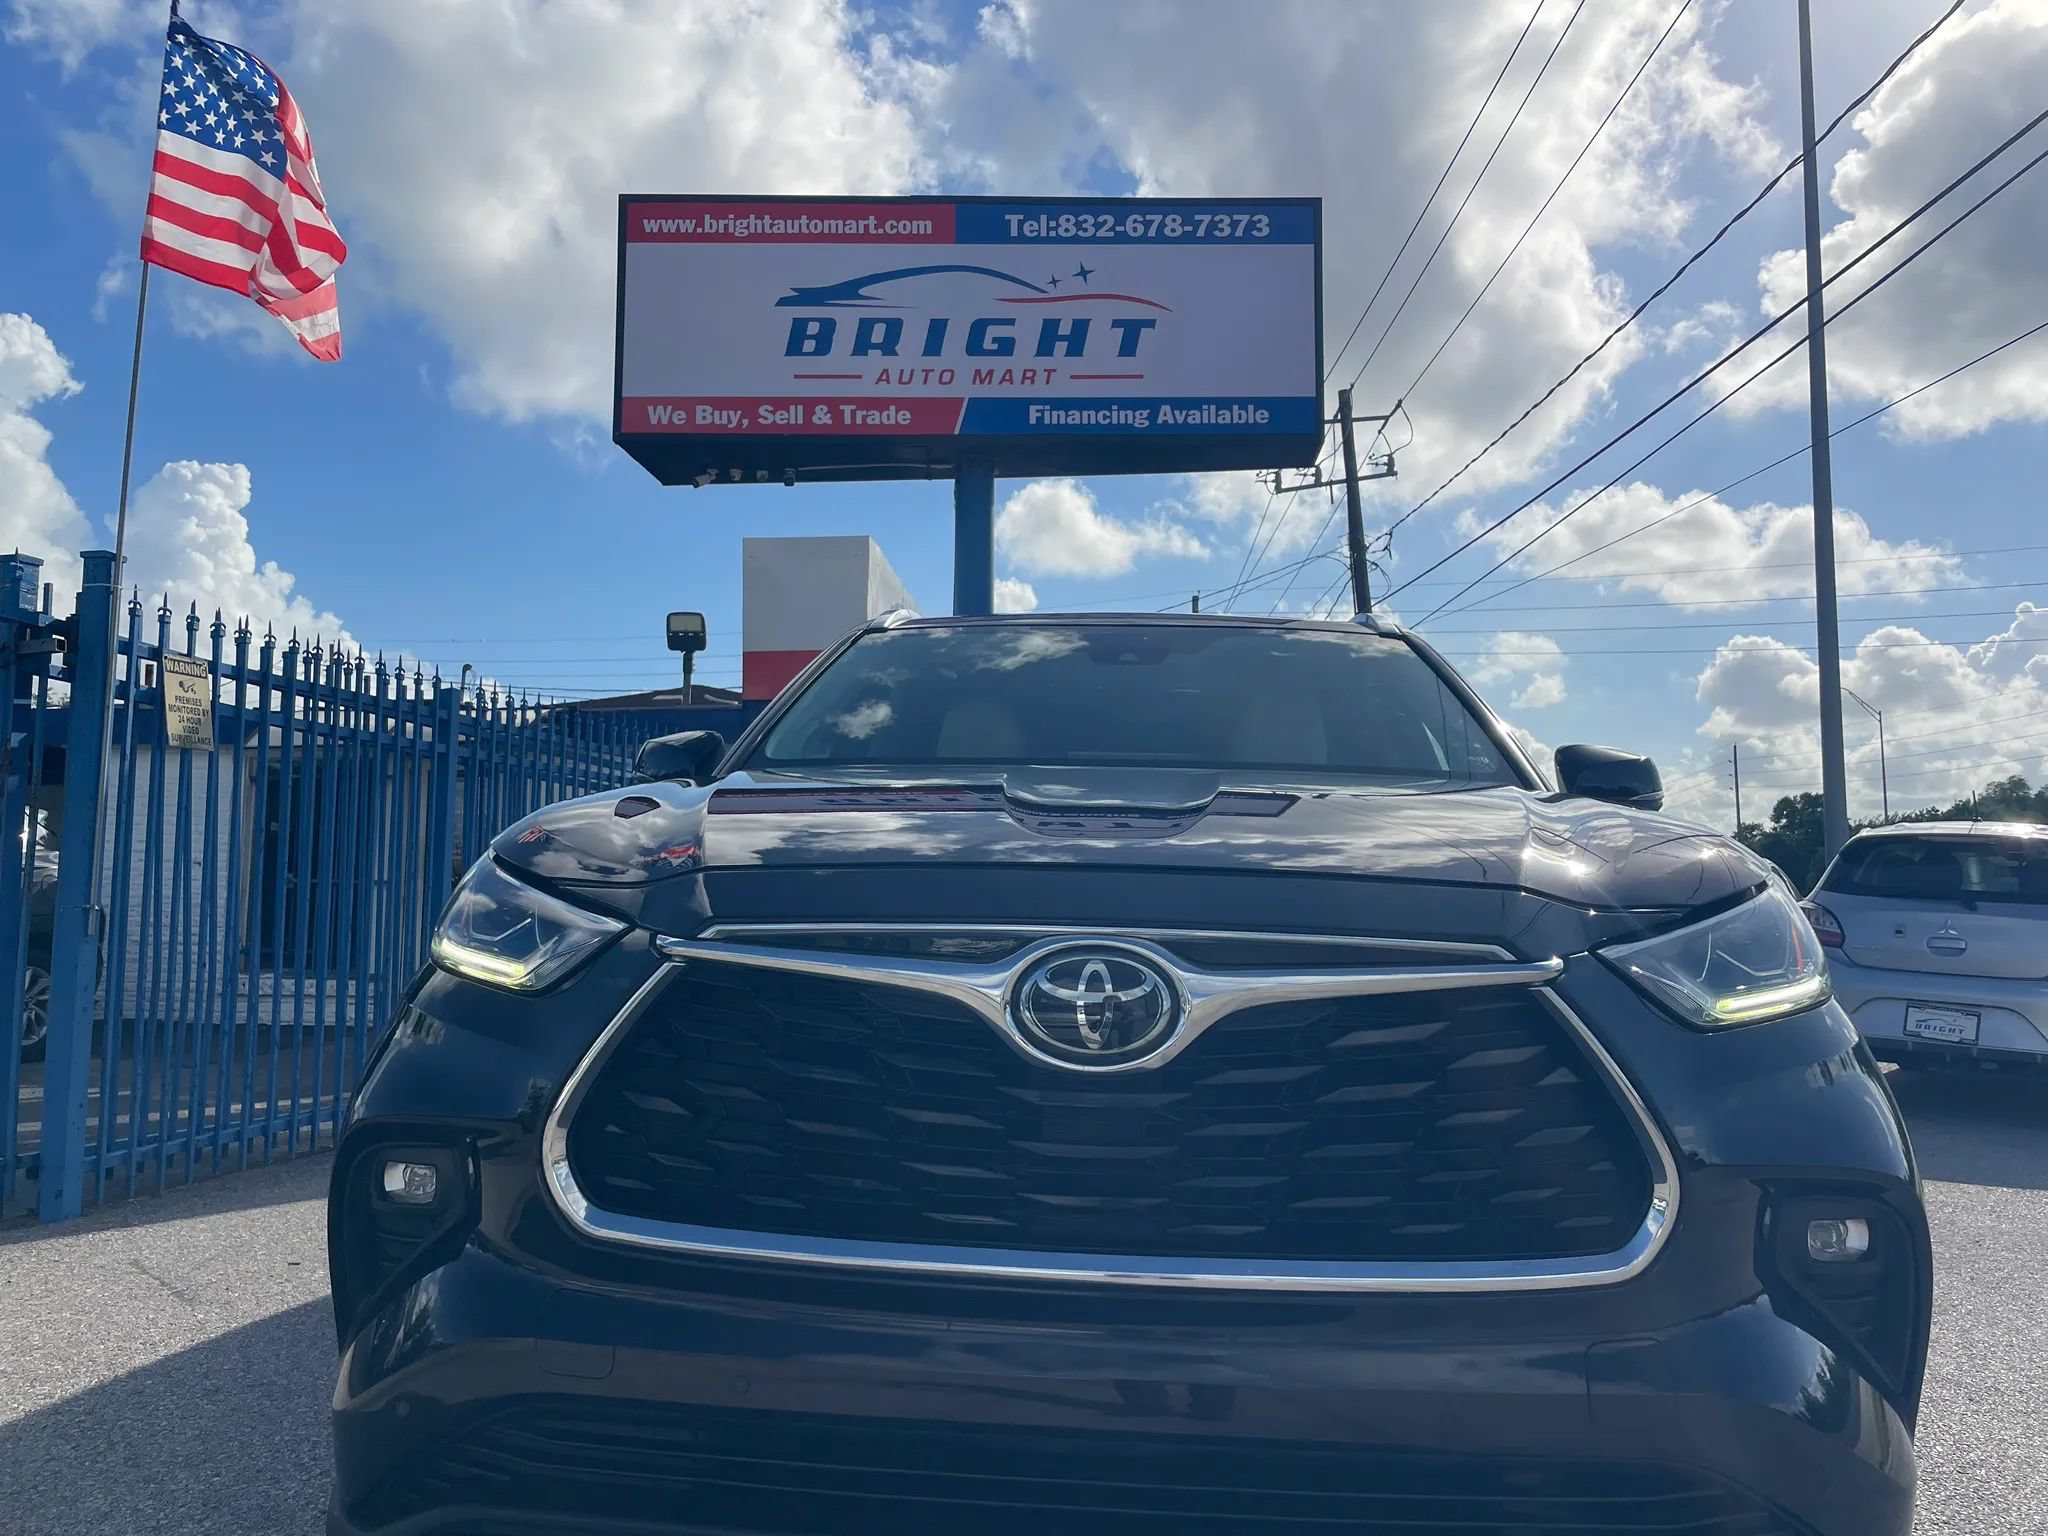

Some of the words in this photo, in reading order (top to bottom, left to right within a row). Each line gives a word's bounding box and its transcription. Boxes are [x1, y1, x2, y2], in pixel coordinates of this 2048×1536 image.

[643, 214, 933, 237] www.brightautomart.com
[1005, 214, 1270, 237] Tel:832-678-7373
[784, 317, 1157, 357] BRIGHT
[875, 368, 956, 385] AUTO
[972, 368, 1058, 385] MART
[647, 405, 687, 425] We
[695, 405, 749, 428] Buy,
[758, 405, 804, 425] Sell
[812, 405, 832, 425] &
[840, 405, 911, 425] Trade
[1029, 405, 1150, 427] Financing
[1157, 405, 1270, 424] Available
[165, 660, 206, 677] WARNING
[175, 696, 202, 707] PREMISES
[168, 704, 201, 716] MONITORED
[202, 709, 209, 717] BY
[178, 715, 185, 723] 24
[186, 716, 201, 726] HOUR
[171, 733, 211, 745] SURVEILLANCE
[182, 726, 199, 735] VIDEO
